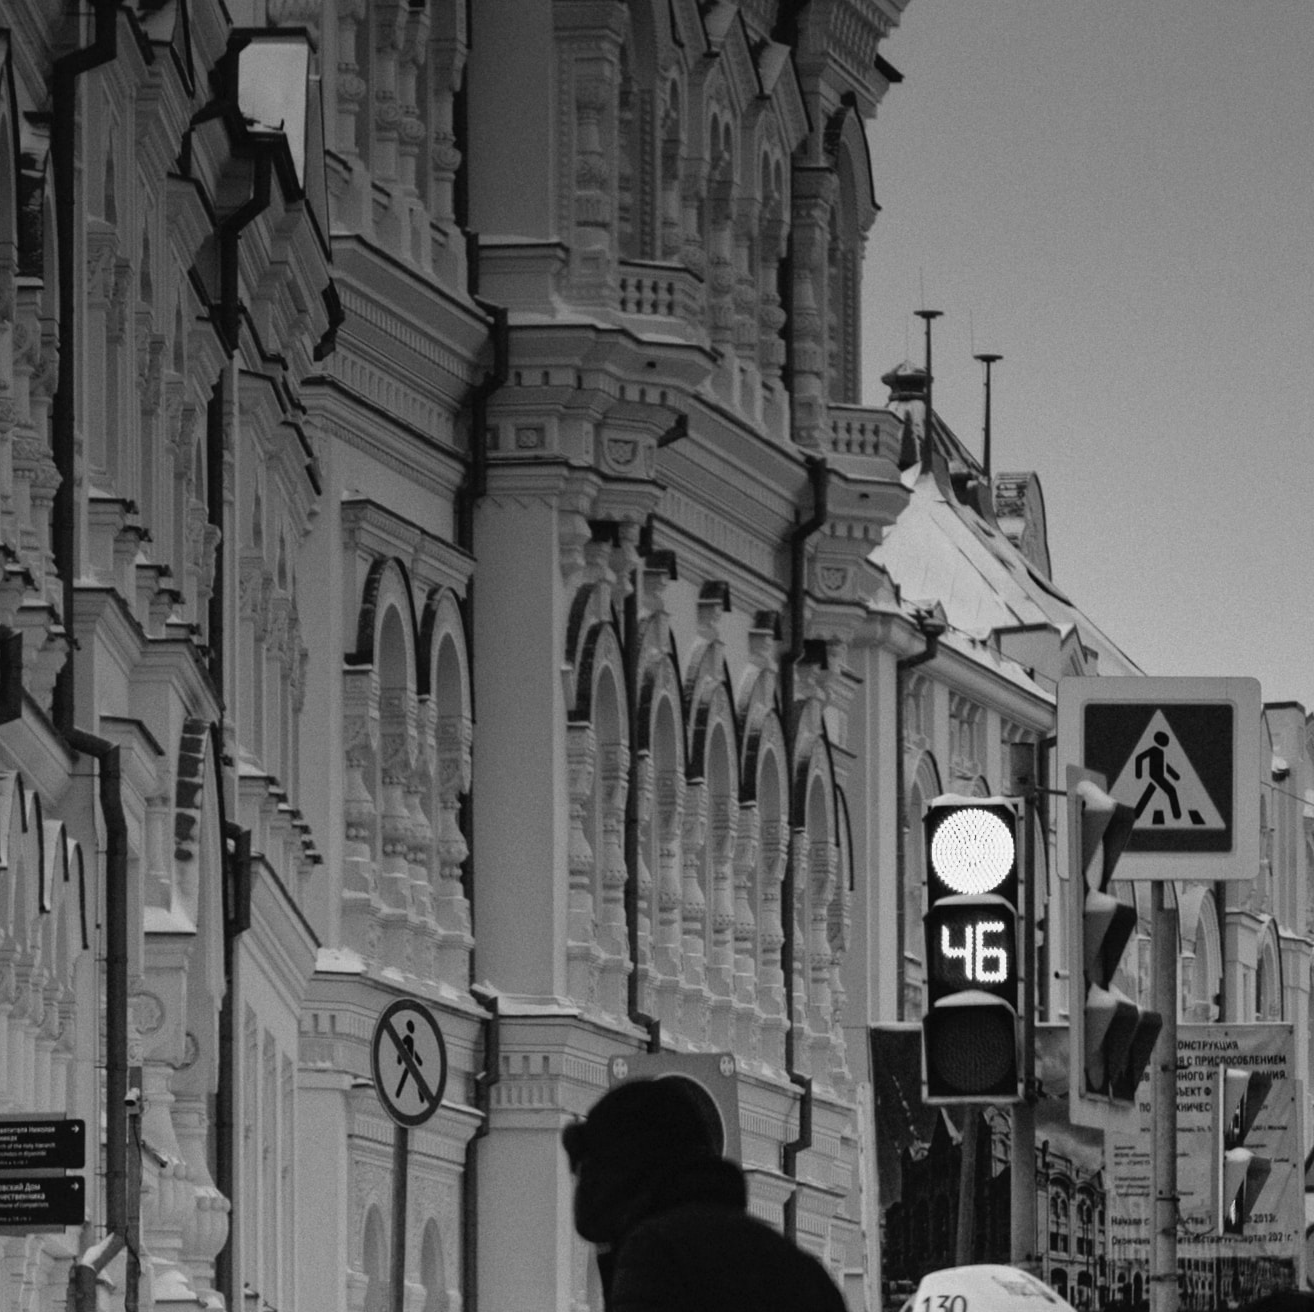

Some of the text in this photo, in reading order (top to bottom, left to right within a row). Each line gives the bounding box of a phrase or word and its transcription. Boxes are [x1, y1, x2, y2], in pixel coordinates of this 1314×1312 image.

[941, 921, 1008, 983] 46
[1176, 1041, 1239, 1053] ОНСТРУКЦИЯ
[1195, 1055, 1287, 1066] ПРИСПОСОБЛЕНИЕМ
[24, 1182, 42, 1193] Дом
